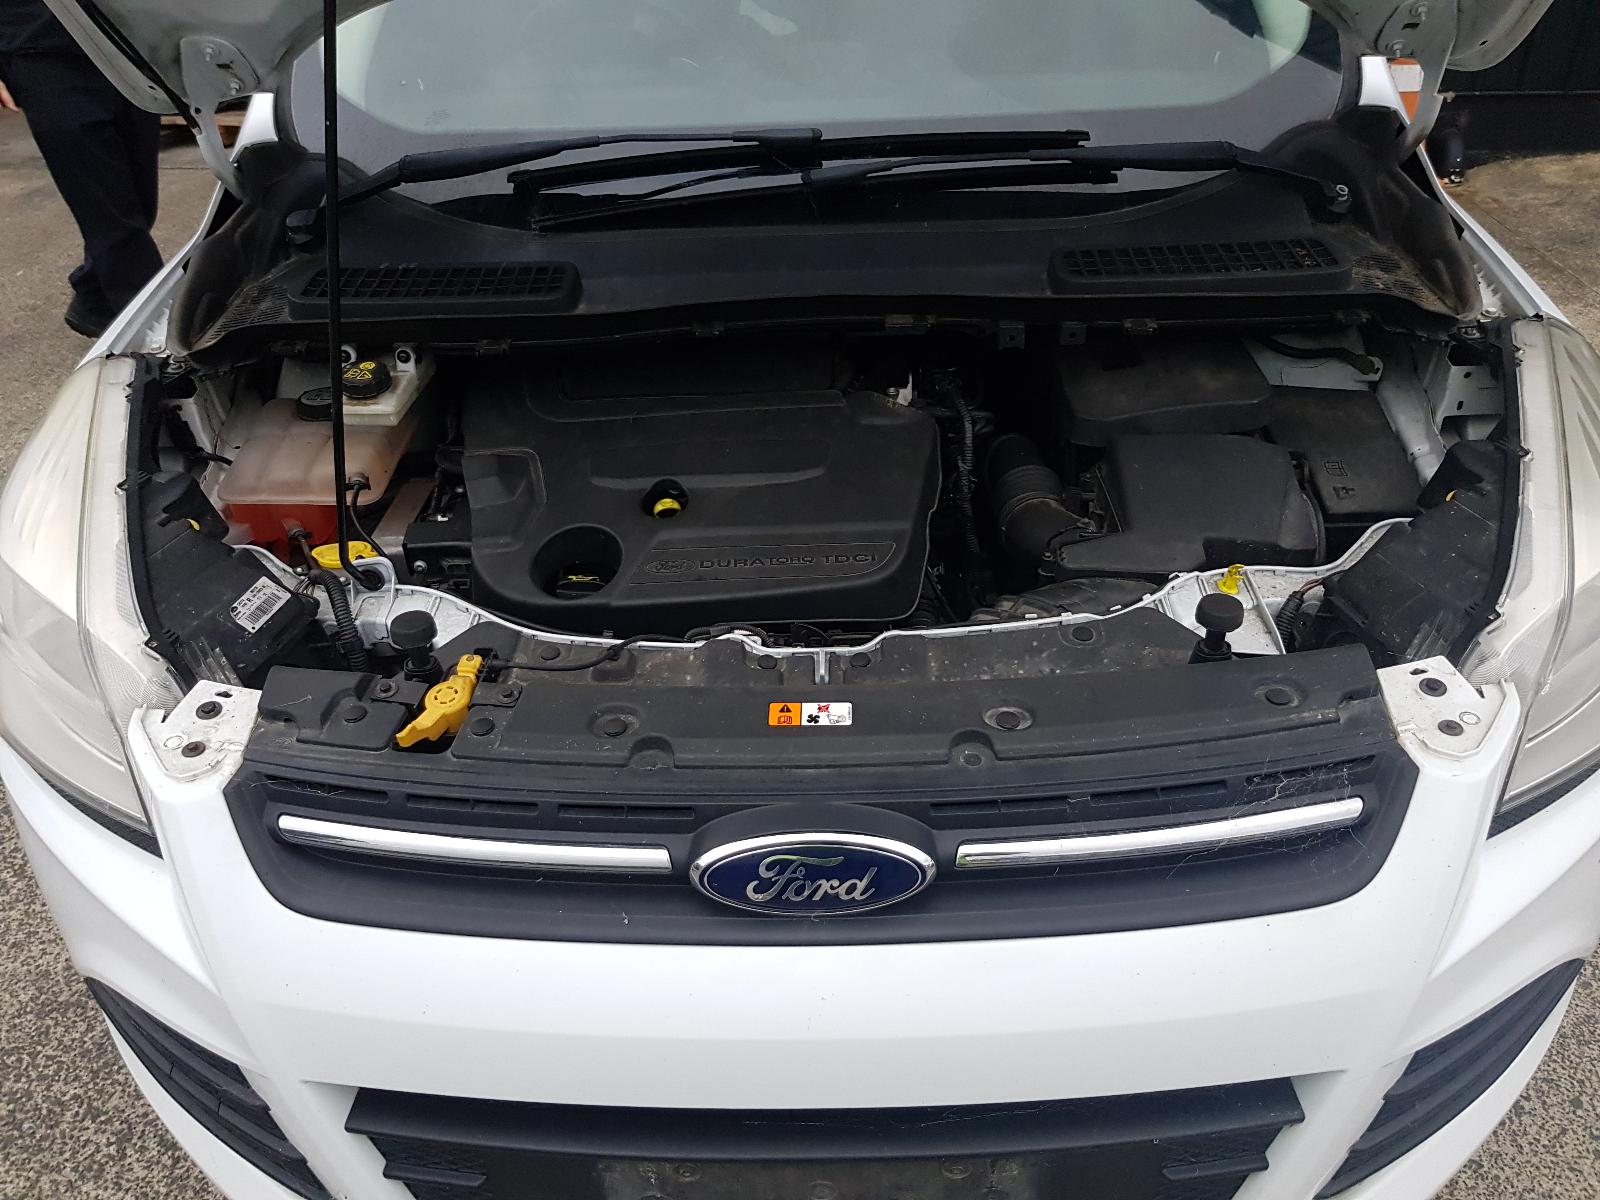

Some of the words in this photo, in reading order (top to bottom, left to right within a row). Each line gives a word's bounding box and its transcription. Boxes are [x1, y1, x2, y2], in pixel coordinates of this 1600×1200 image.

[655, 559, 688, 572] Ford
[699, 555, 815, 569] DURATORQ
[746, 854, 878, 901] Ford
